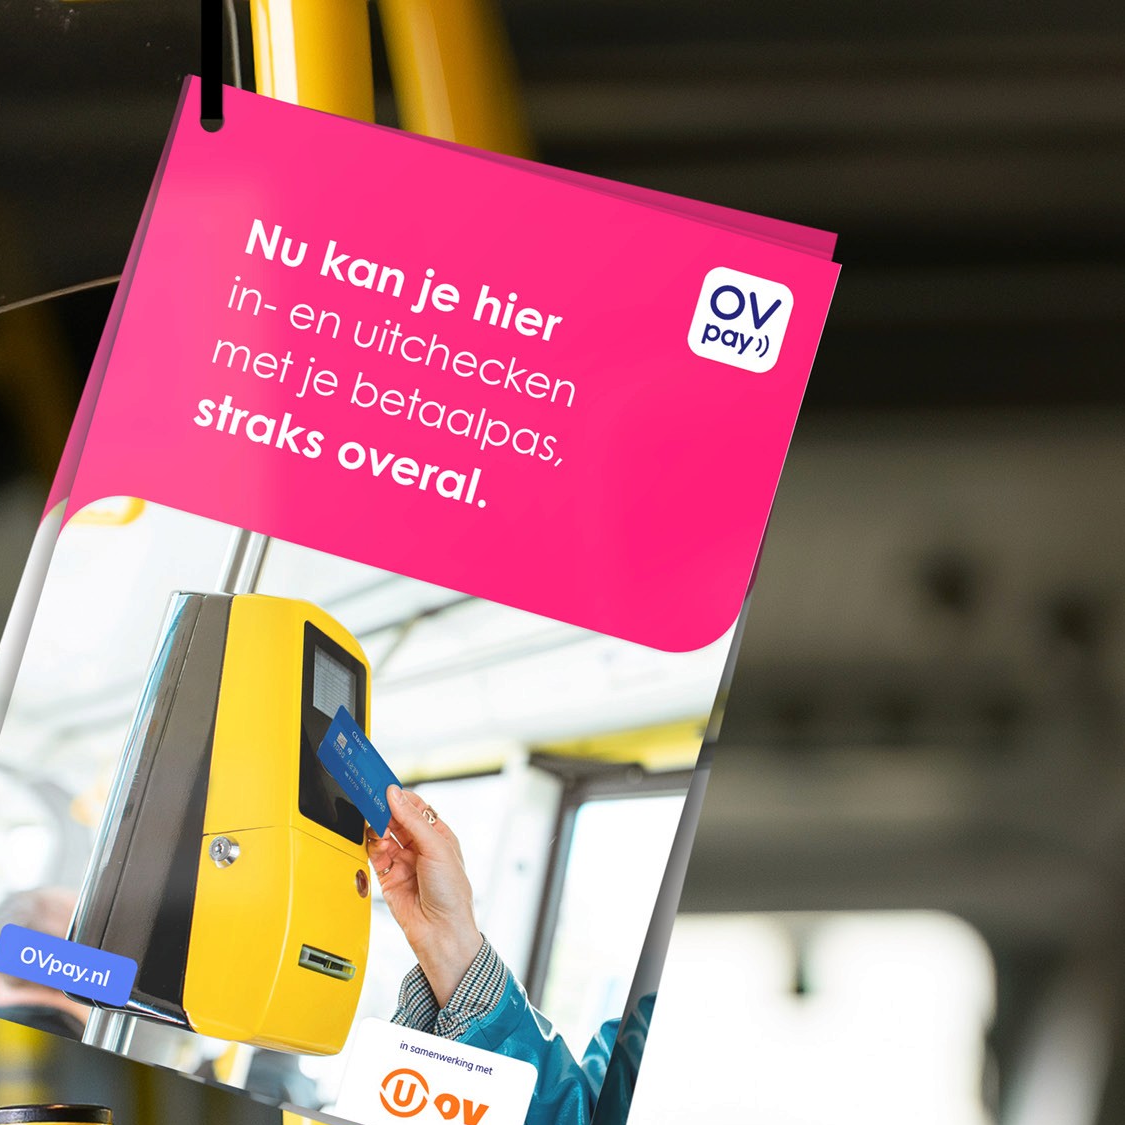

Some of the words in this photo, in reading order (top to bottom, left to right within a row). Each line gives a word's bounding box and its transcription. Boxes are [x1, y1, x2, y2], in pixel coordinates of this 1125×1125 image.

[244, 218, 308, 268] Nu
[319, 239, 405, 298] kan
[410, 268, 460, 314] je
[472, 284, 564, 342] hier
[709, 284, 782, 330] OV
[227, 275, 277, 316] in-
[289, 303, 341, 339] en
[353, 319, 576, 408] uitchecken
[700, 323, 754, 355] pay
[209, 339, 294, 383] met
[295, 357, 338, 398] je
[350, 371, 563, 467] betaalpas,
[193, 394, 325, 460] straks
[337, 441, 487, 509] overal.
[20, 946, 111, 987] OVpay.nl
[399, 1040, 409, 1051] in
[410, 1044, 474, 1072] samenwerking
[475, 1064, 493, 1076] met
